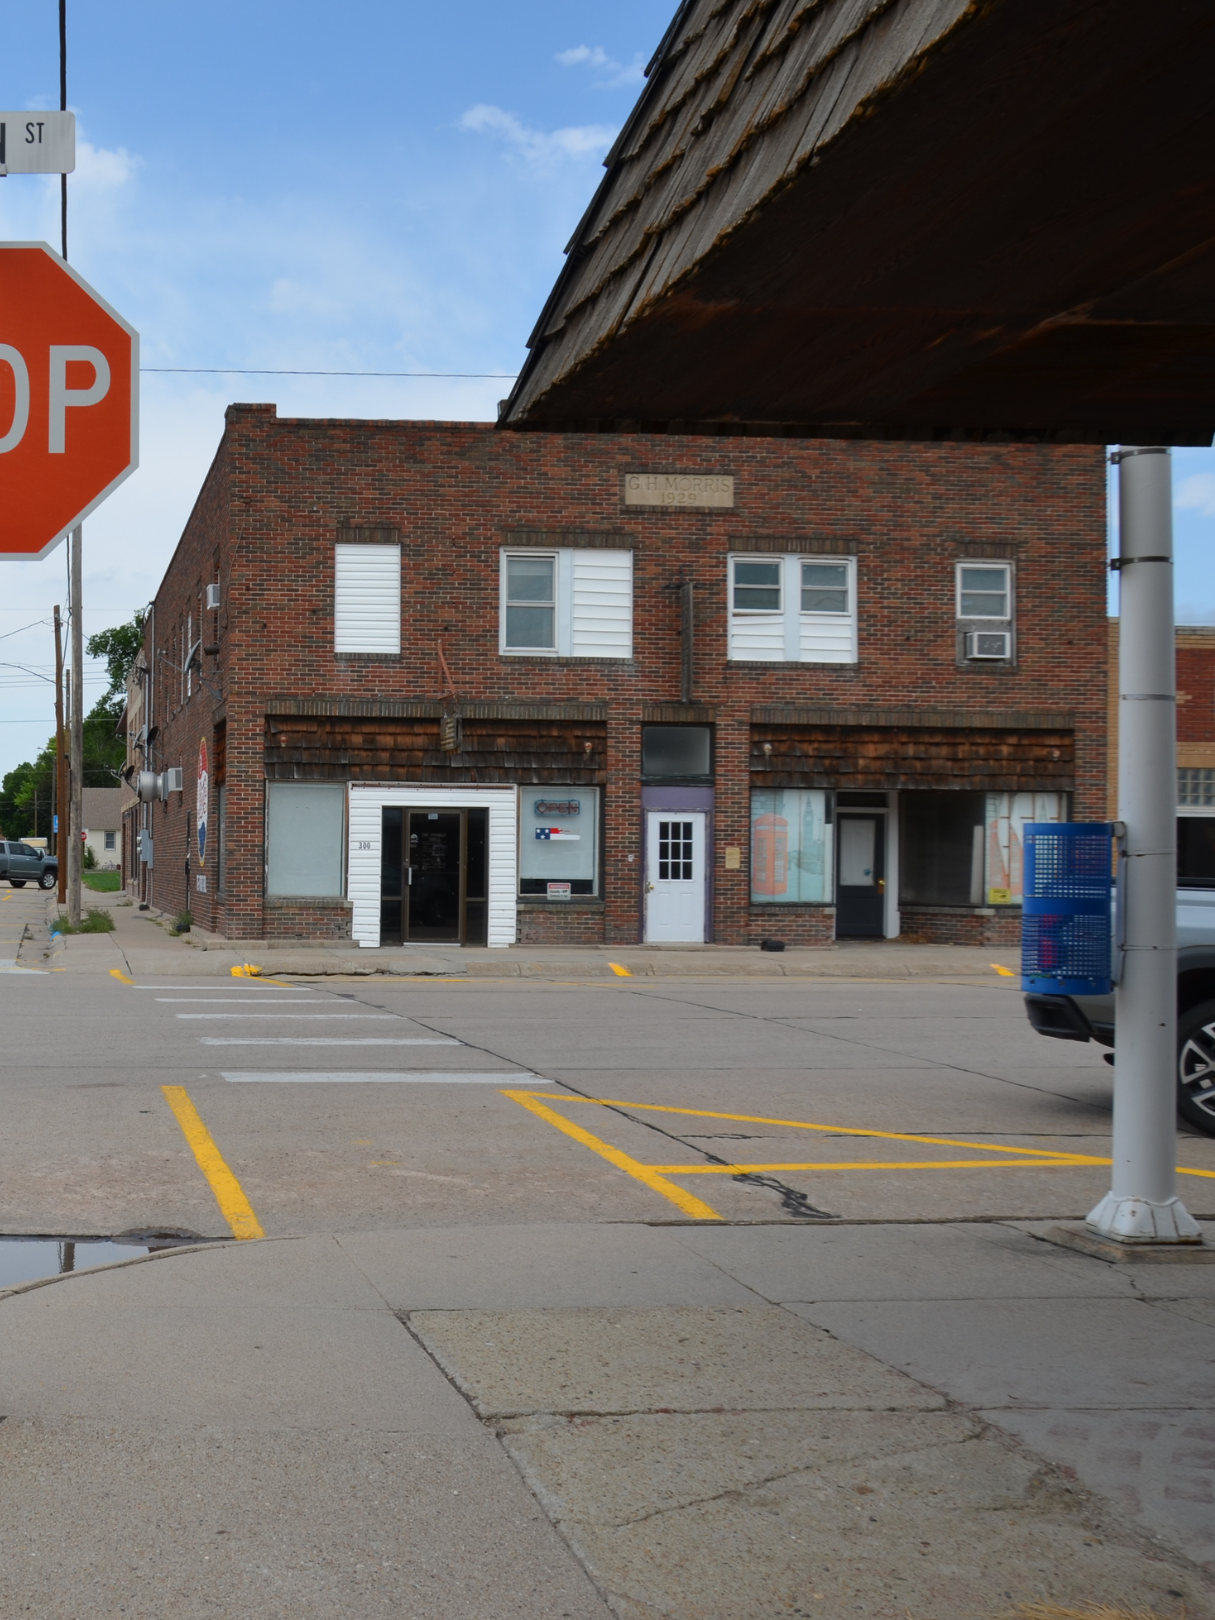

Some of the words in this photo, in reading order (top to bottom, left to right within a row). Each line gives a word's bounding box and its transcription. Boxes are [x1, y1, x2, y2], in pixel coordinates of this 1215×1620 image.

[24, 122, 45, 144] ST
[665, 477, 731, 493] MORRIS
[661, 492, 697, 505] 1929
[537, 802, 578, 814] OPEN
[358, 841, 371, 850] 300
